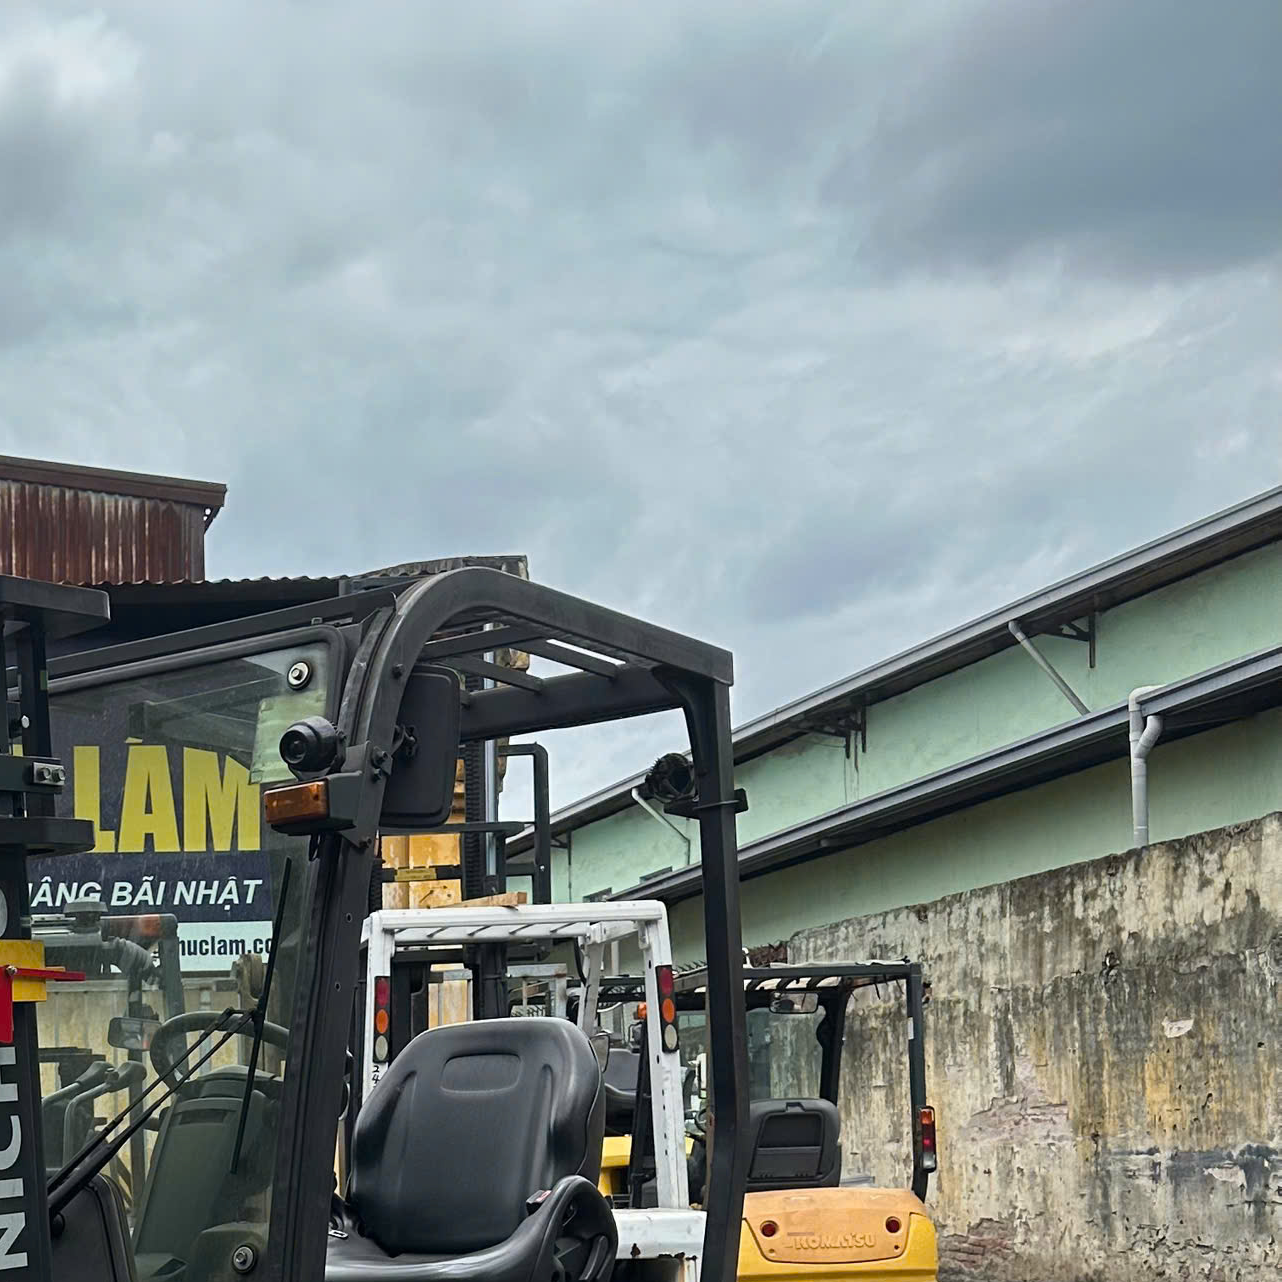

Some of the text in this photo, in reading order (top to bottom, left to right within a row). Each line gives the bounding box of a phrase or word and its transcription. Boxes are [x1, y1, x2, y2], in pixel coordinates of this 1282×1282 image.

[28, 876, 263, 910] ÂNG BÃI NHẬT
[794, 1231, 877, 1250] KOMATSU
